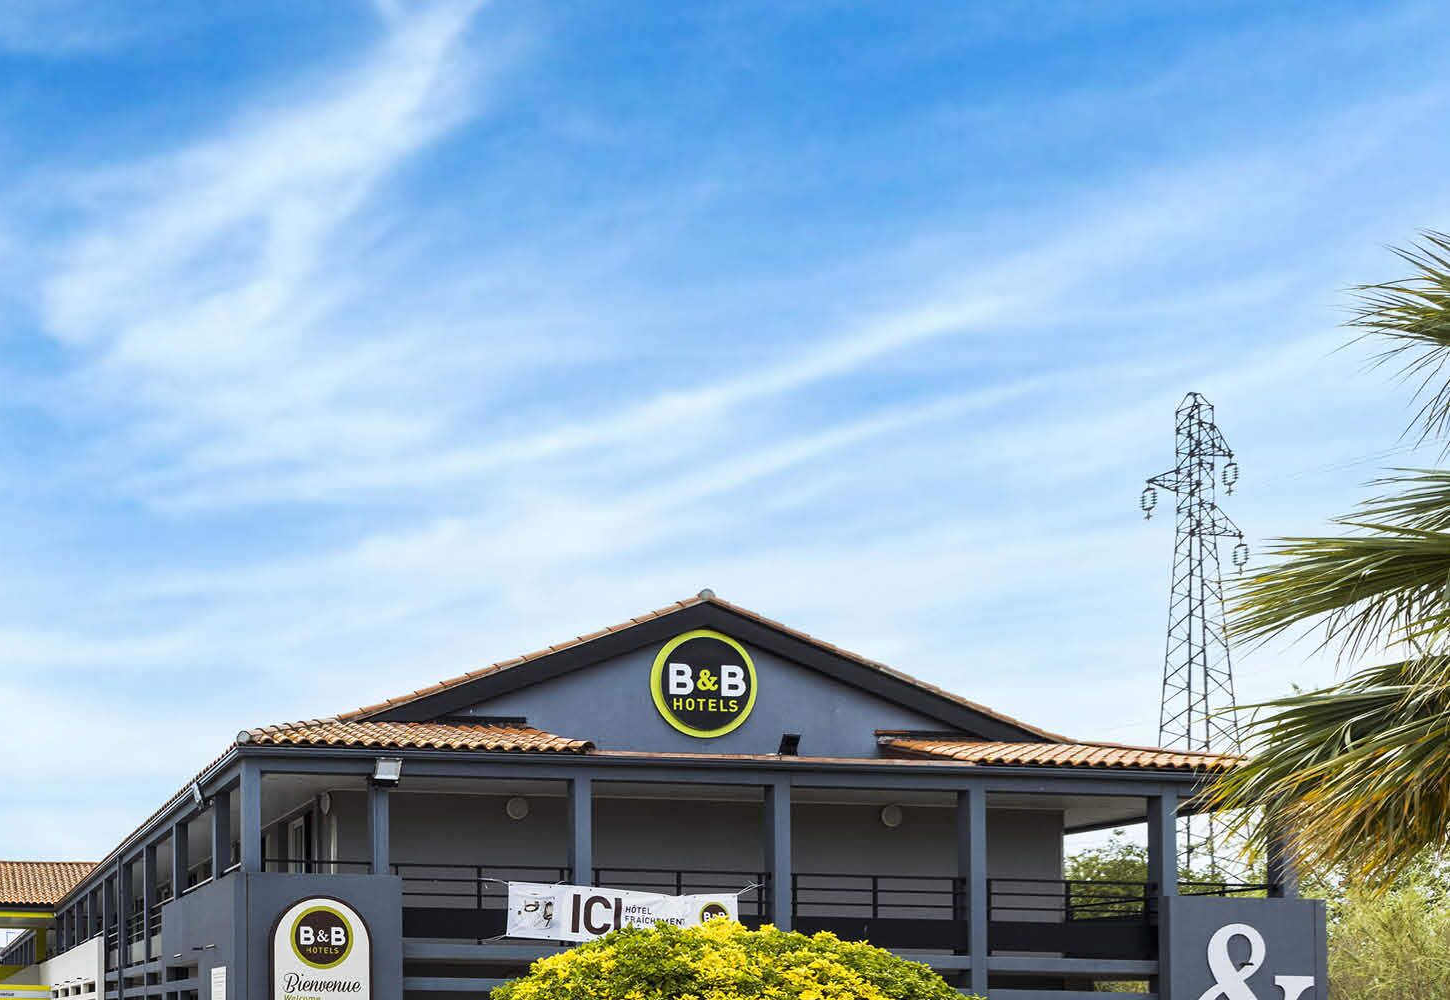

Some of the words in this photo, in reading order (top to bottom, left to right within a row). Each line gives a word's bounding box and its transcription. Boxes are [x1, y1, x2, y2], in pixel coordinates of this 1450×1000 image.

[669, 663, 746, 697] B&B
[673, 698, 739, 712] HOTELS
[571, 894, 623, 936] ICI
[625, 904, 653, 915] HÔTEL
[300, 926, 346, 946] B&B
[305, 946, 340, 954] HOTELS
[283, 972, 362, 994] Bienvenue
